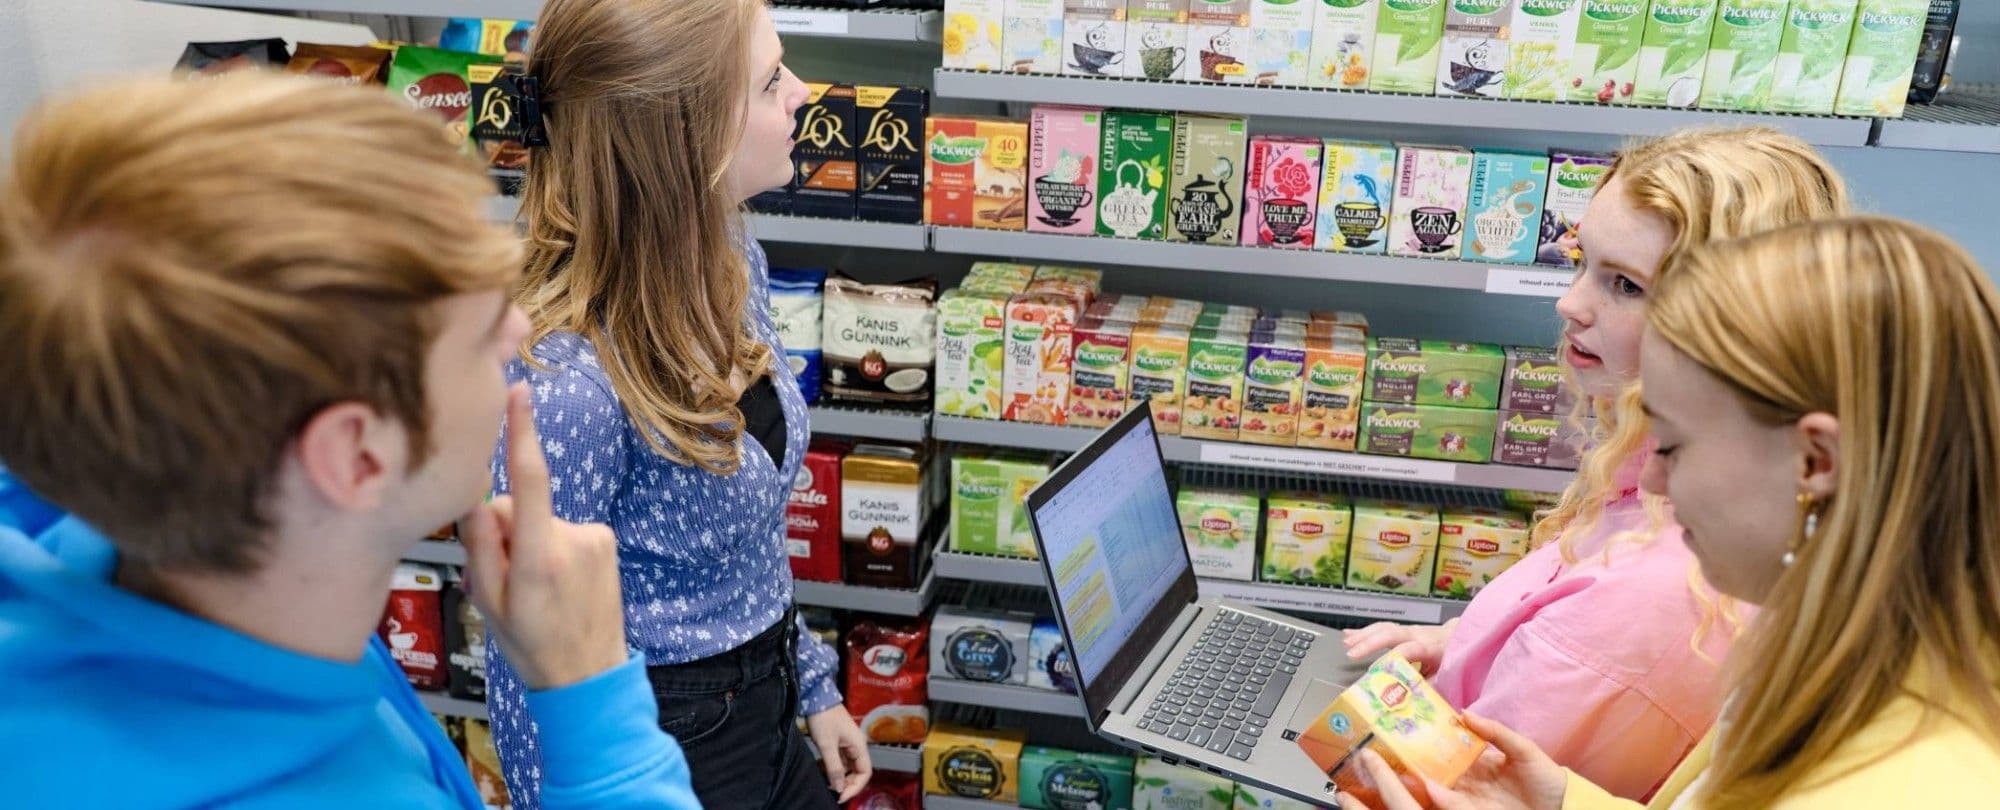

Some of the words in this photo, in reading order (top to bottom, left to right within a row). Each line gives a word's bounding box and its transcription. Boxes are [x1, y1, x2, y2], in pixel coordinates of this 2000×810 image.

[1585, 0, 1640, 15] PICKWICK
[1653, 3, 1709, 18] PICKWICK
[1722, 5, 1781, 21] PICKWICK
[1791, 9, 1850, 24] PICKWICK
[1861, 11, 1921, 27] PICKWICK
[795, 104, 853, 149] L'OR
[859, 108, 919, 153] L'OR
[998, 138, 1018, 153] 40
[1033, 113, 1045, 169] CLIPPER
[1103, 116, 1116, 171] CLIPPER
[929, 142, 983, 158] PICKWICK
[1175, 121, 1188, 176] CLIPPER
[1326, 149, 1338, 192] CLIPPER
[1400, 152, 1413, 197] CLIPPER
[1473, 159, 1488, 207] CLIPPER
[1039, 195, 1081, 206] ORGANIC
[1191, 192, 1208, 202] 20
[1264, 204, 1290, 214] LOVE
[1291, 205, 1306, 215] ME
[1335, 208, 1379, 219] CALMER
[1178, 212, 1219, 226] EARL
[1266, 212, 1302, 224] TRULY
[1336, 217, 1376, 226] CHAMELEON
[1415, 212, 1454, 226] ZEN
[1416, 224, 1449, 235] AGAIN
[856, 315, 899, 333] KANIS
[841, 328, 912, 349] GUNNINK
[1079, 348, 1121, 363] PICKWICK
[1192, 358, 1238, 373] PICKWICK
[1250, 365, 1297, 379] PICKWICK
[1371, 359, 1427, 373] PICKWICK
[1309, 368, 1357, 382] PICKWICK
[1510, 368, 1566, 383] PICKWICK
[1377, 382, 1414, 391] ENGLISH
[1511, 391, 1533, 399] EARL
[1366, 416, 1421, 430] PICKWICK
[1502, 420, 1558, 437] PICKWICK
[1503, 443, 1525, 452] EARL
[1525, 446, 1548, 454] GREY
[859, 499, 900, 512] KANIS
[787, 517, 819, 529] ROMA
[848, 509, 911, 523] GUNNINK
[1203, 520, 1230, 530] Lipton
[1296, 522, 1322, 533] Lipton
[1380, 533, 1409, 543] Lipton
[1469, 541, 1497, 552] Lipton
[957, 648, 995, 665] Grey
[1050, 782, 1099, 798] Melange
